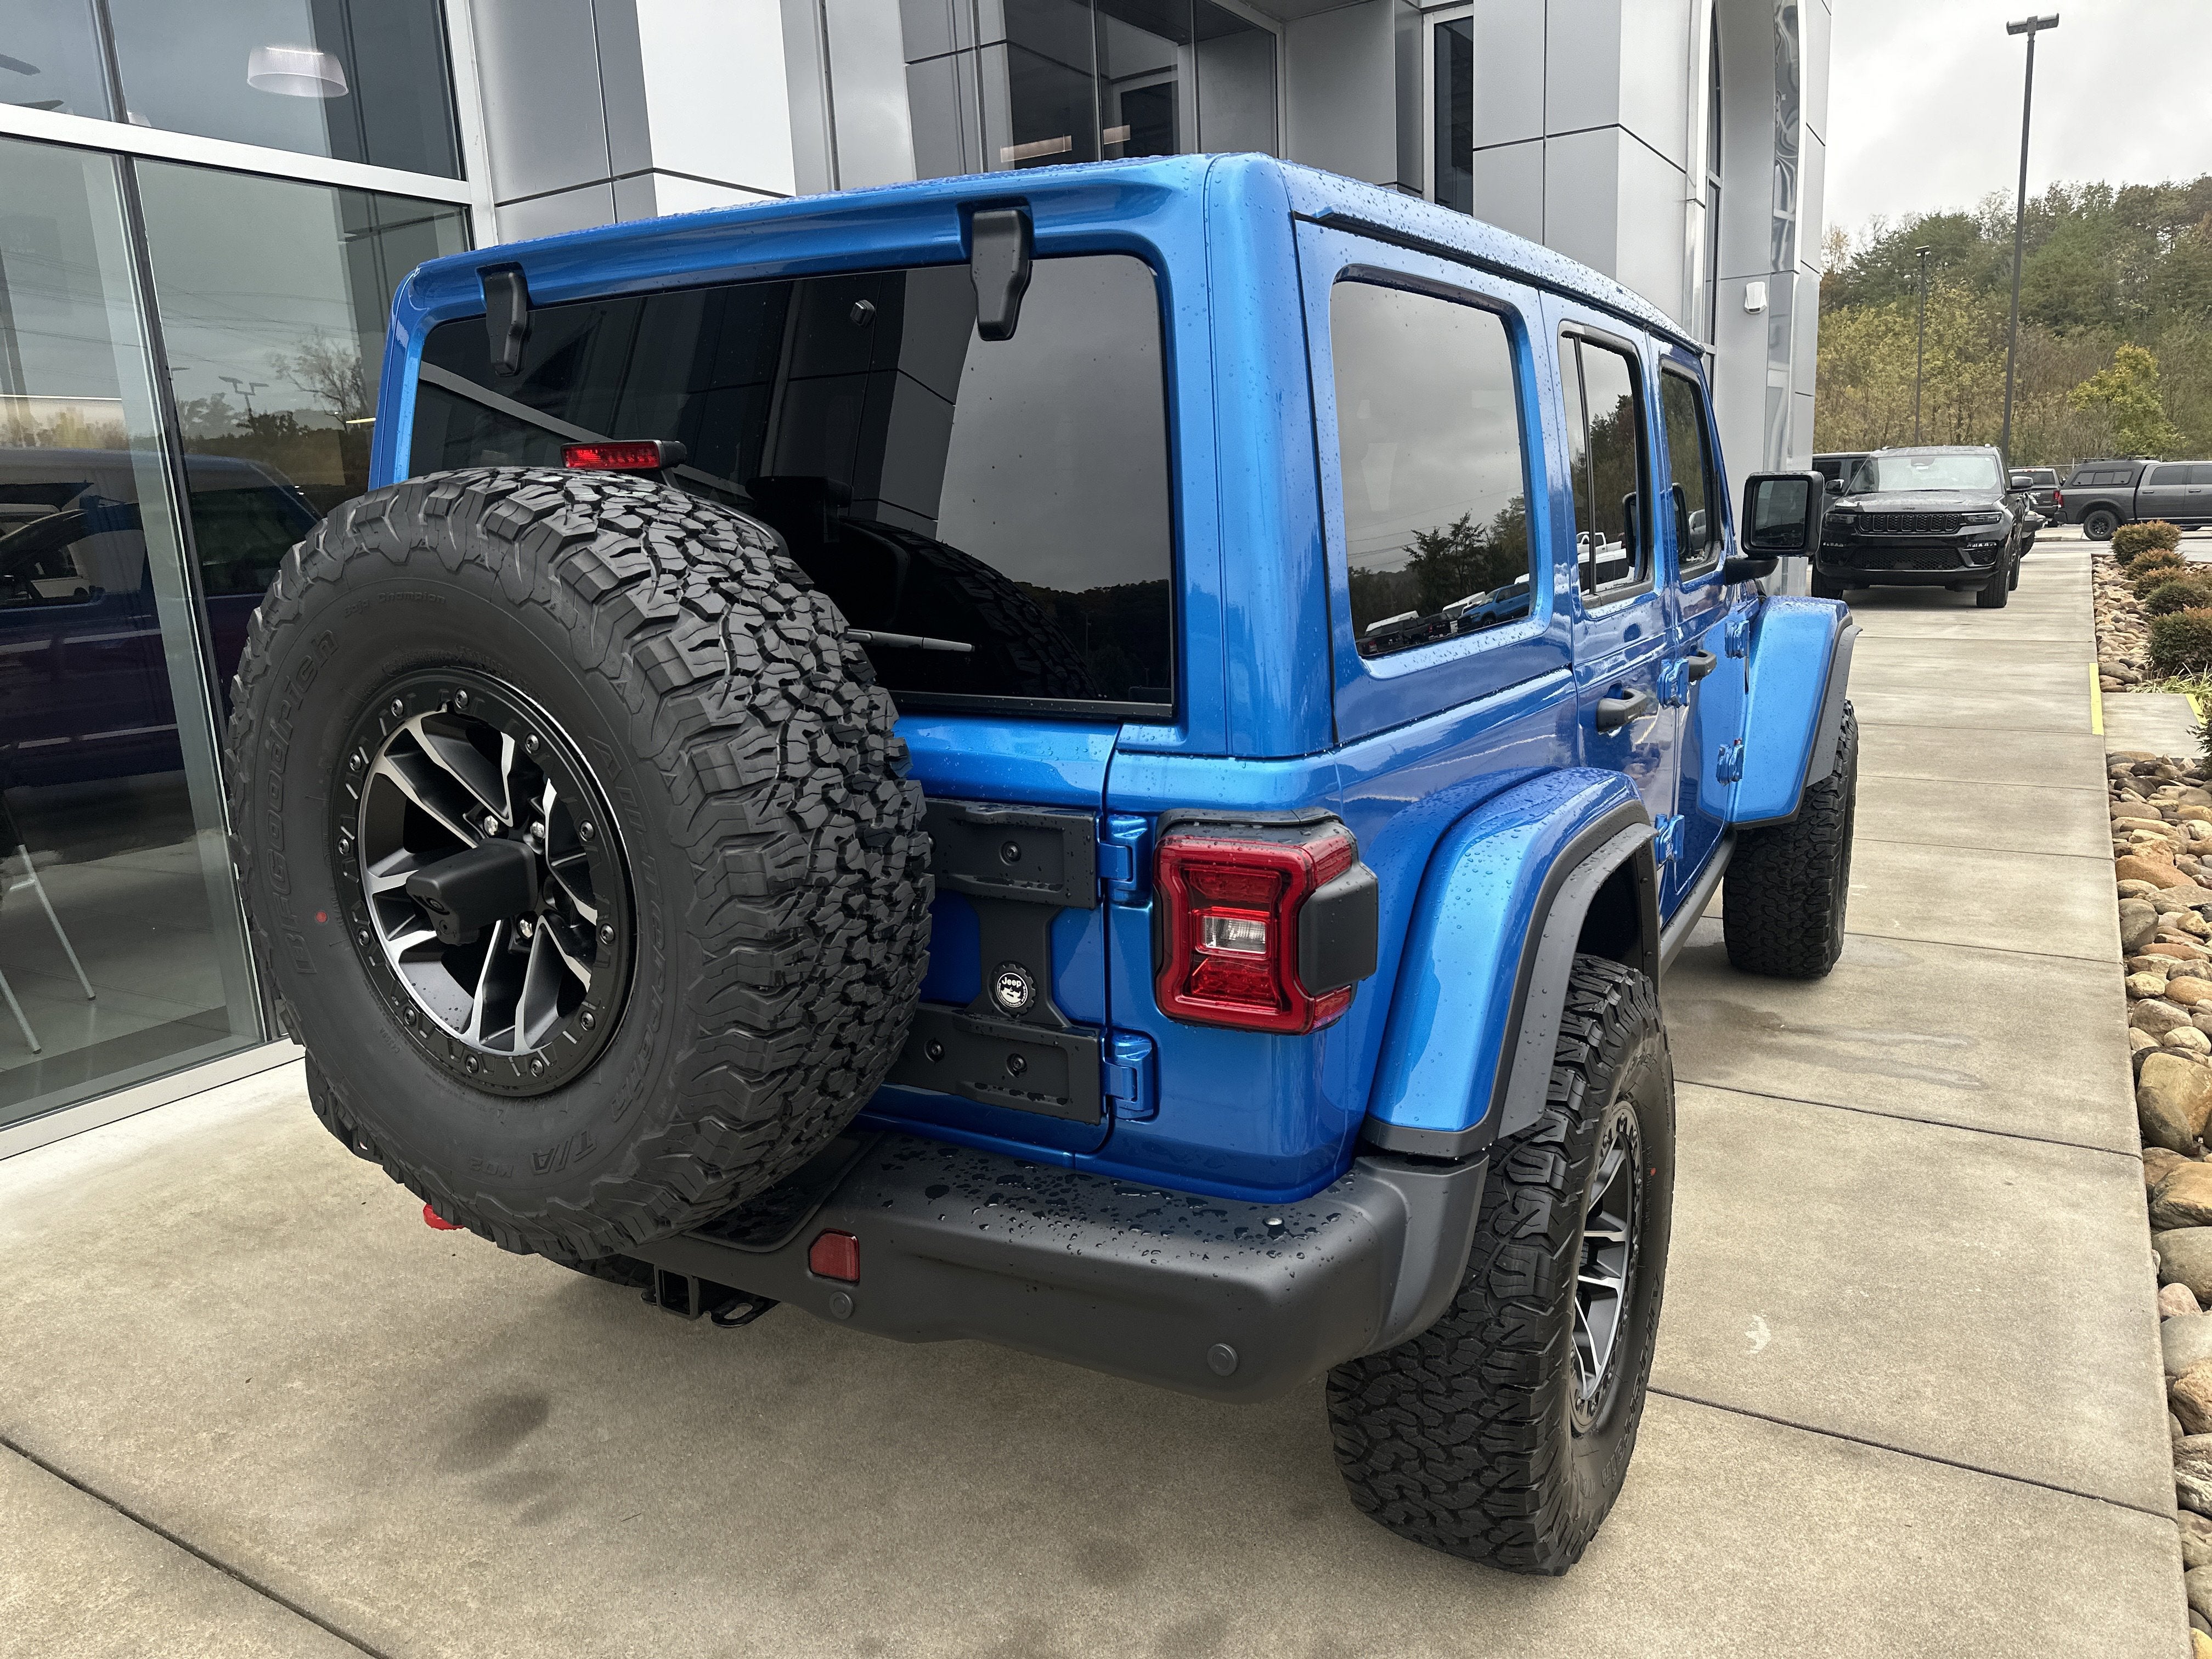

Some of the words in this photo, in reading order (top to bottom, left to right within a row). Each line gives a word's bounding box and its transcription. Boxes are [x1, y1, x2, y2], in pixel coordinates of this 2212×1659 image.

[377, 591, 445, 604] Champion
[266, 629, 340, 975] BFGoodrich
[1002, 977, 1022, 988] Jeep
[530, 1129, 598, 1176] T/A
